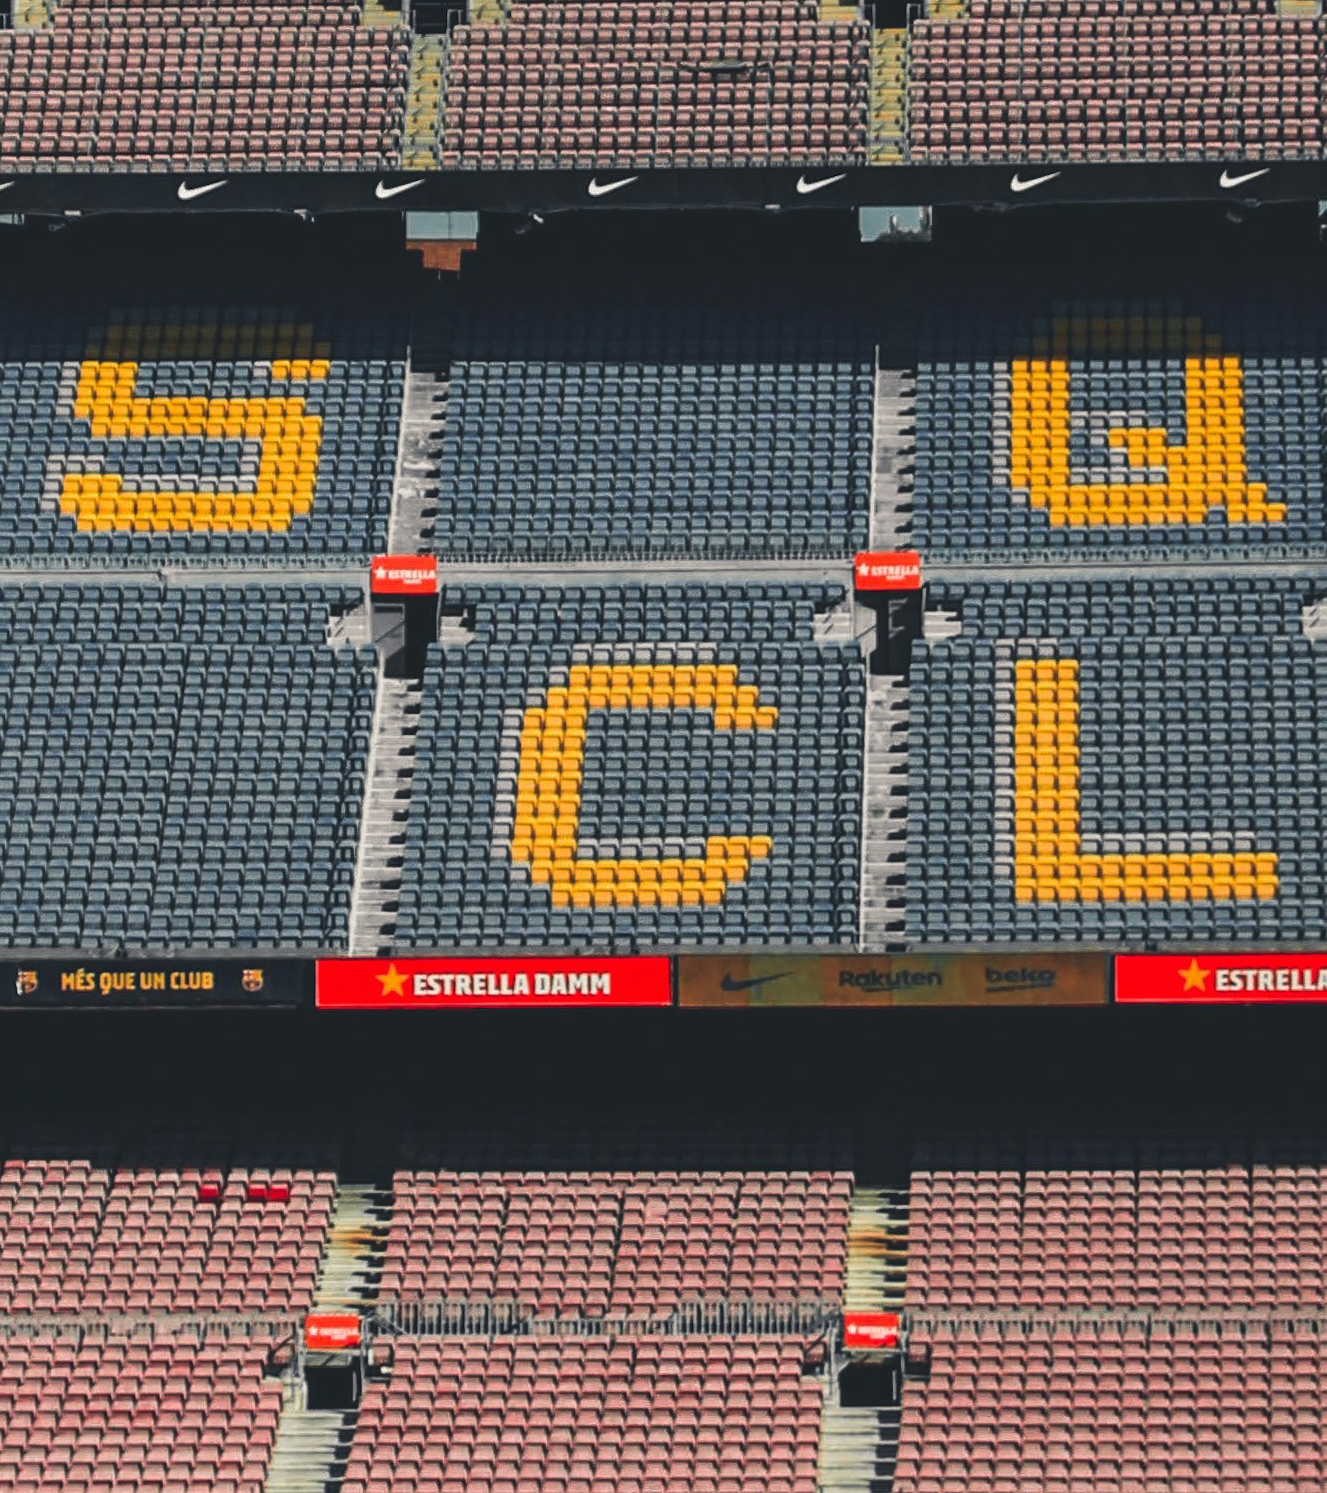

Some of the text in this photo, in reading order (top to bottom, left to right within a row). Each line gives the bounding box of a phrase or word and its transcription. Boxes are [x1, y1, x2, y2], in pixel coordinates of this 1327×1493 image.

[61, 968, 214, 995] MÉS QUE UN CLUB
[413, 973, 611, 997] ESTRELLA DAMM
[839, 968, 943, 991] Rakuten
[985, 967, 1057, 989] beko
